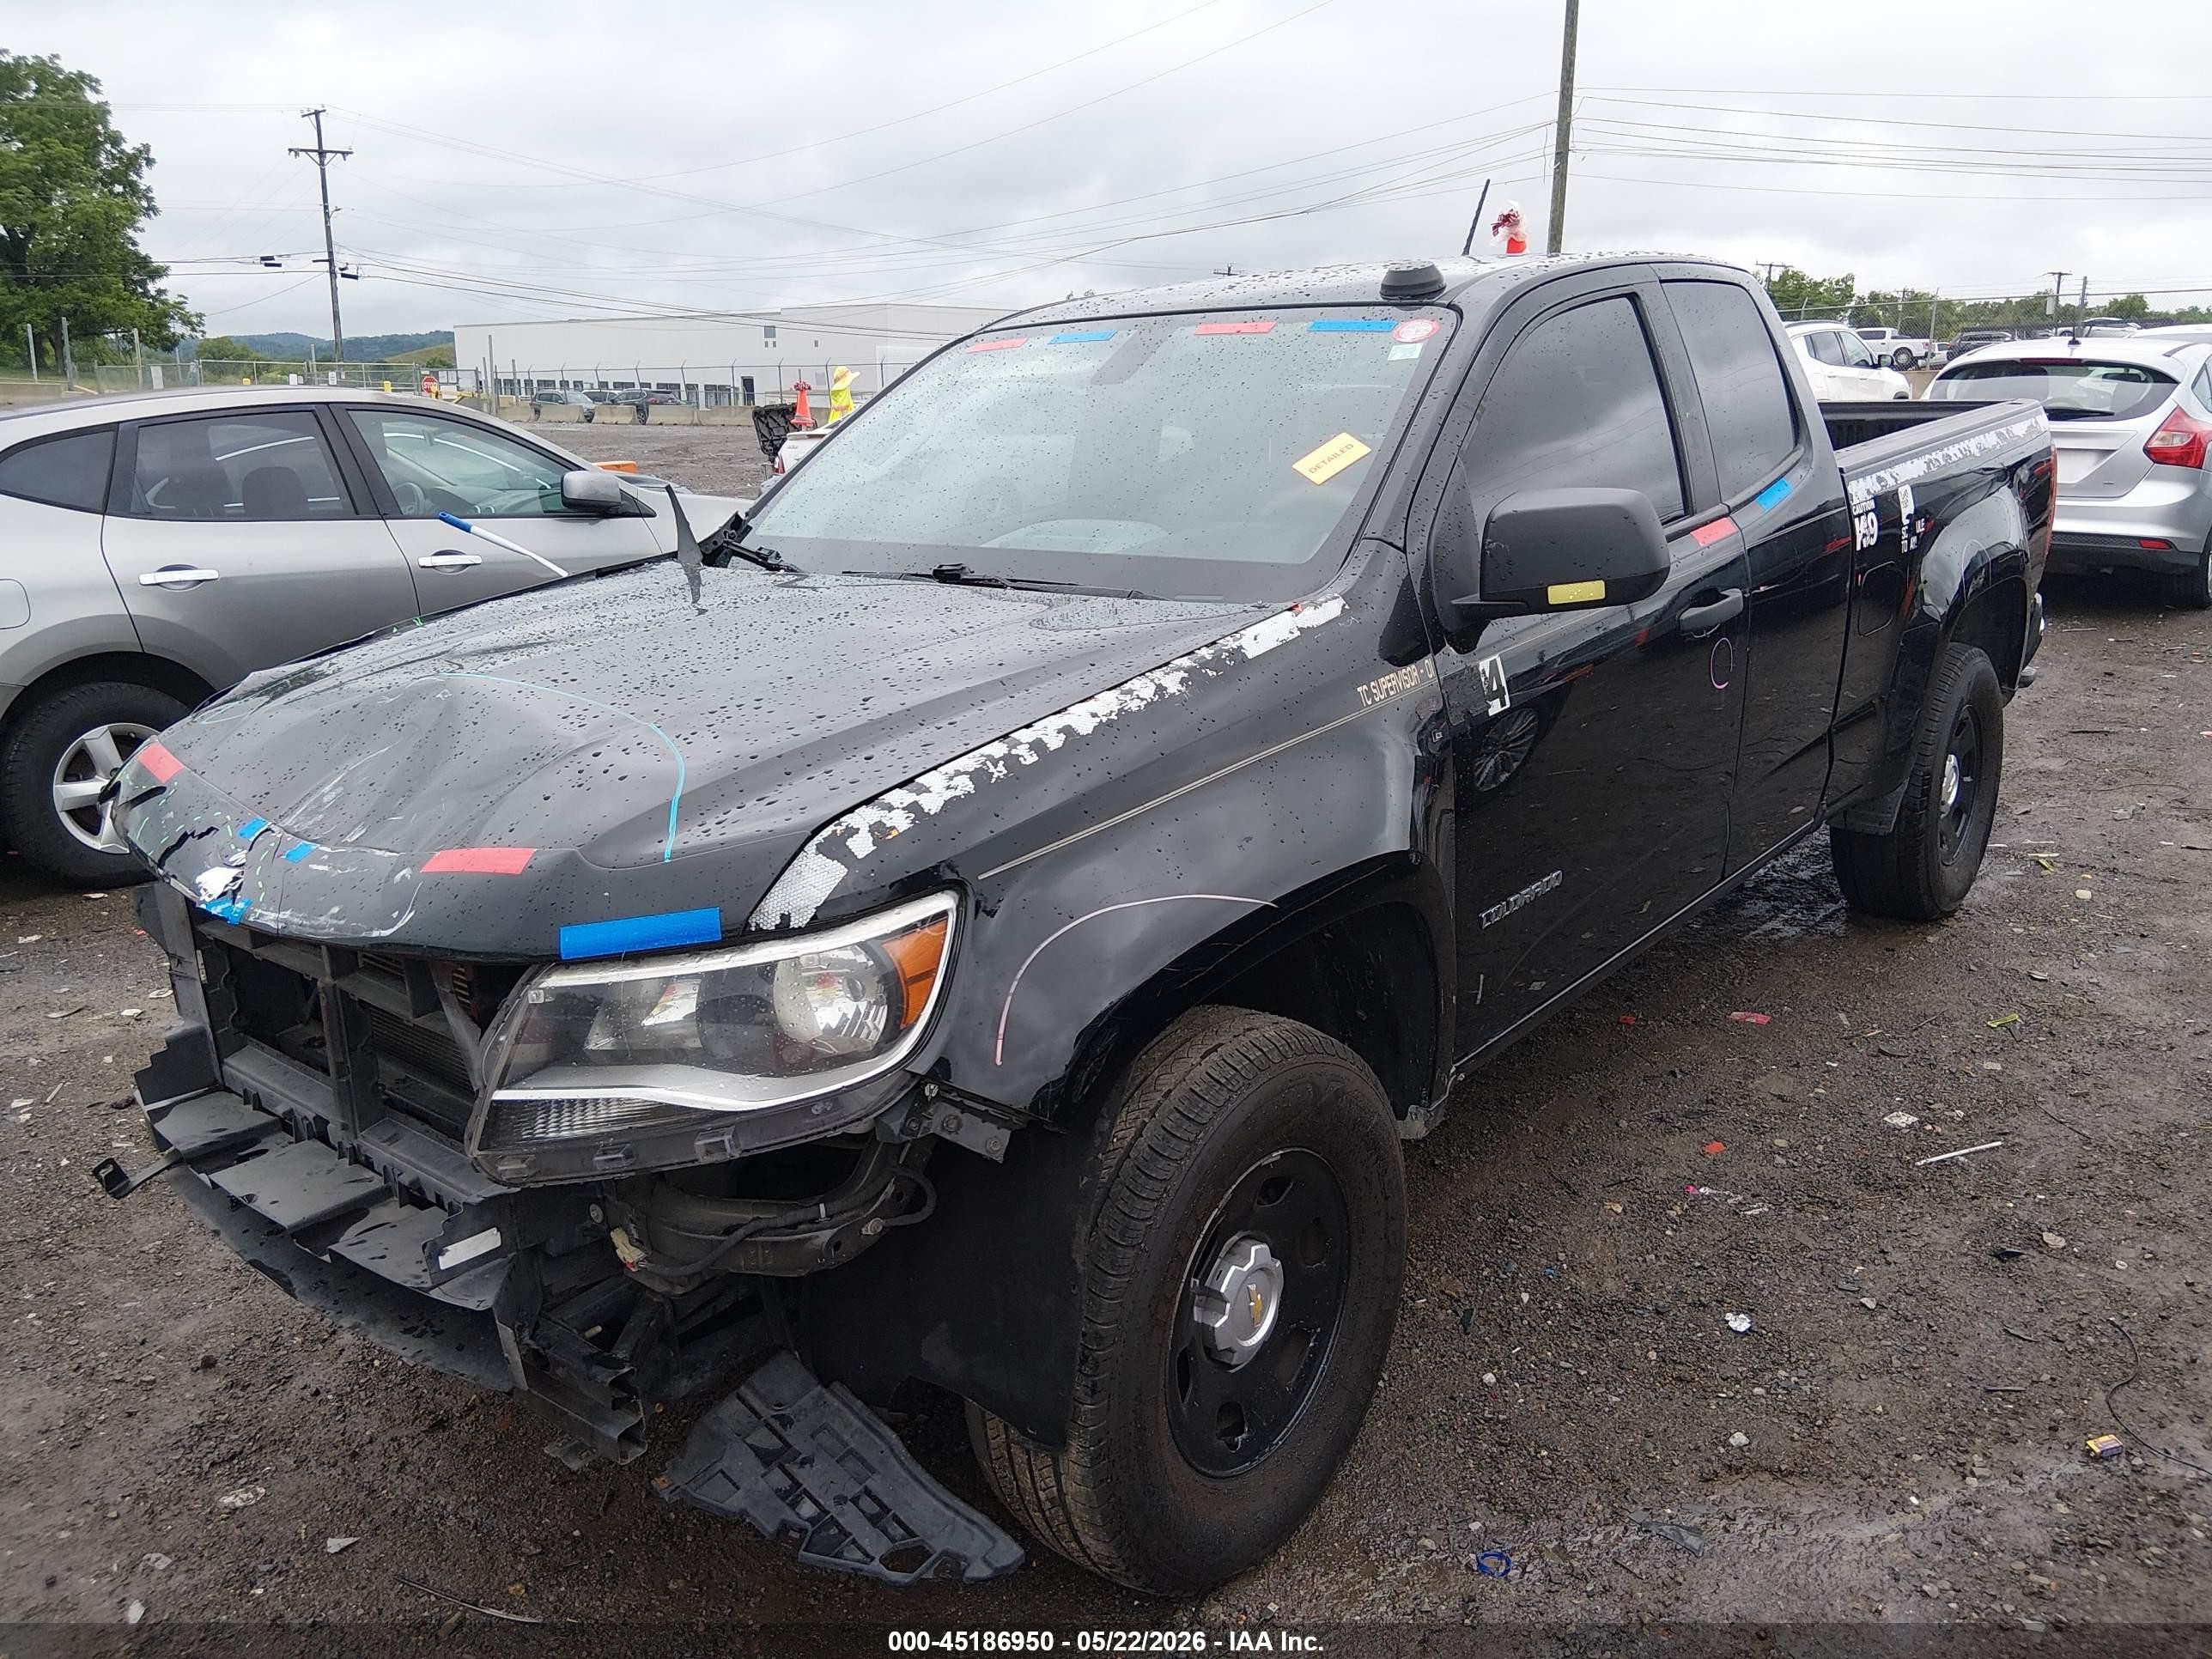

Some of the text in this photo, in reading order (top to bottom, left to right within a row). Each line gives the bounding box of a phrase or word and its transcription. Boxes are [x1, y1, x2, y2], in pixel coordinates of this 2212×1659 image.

[1308, 443, 1354, 474] DETAILED
[1852, 499, 1875, 515] CAUTION
[1357, 684, 1373, 708] TC
[1370, 665, 1420, 702] SUPERVISOR
[1478, 870, 1563, 929] COLORADO
